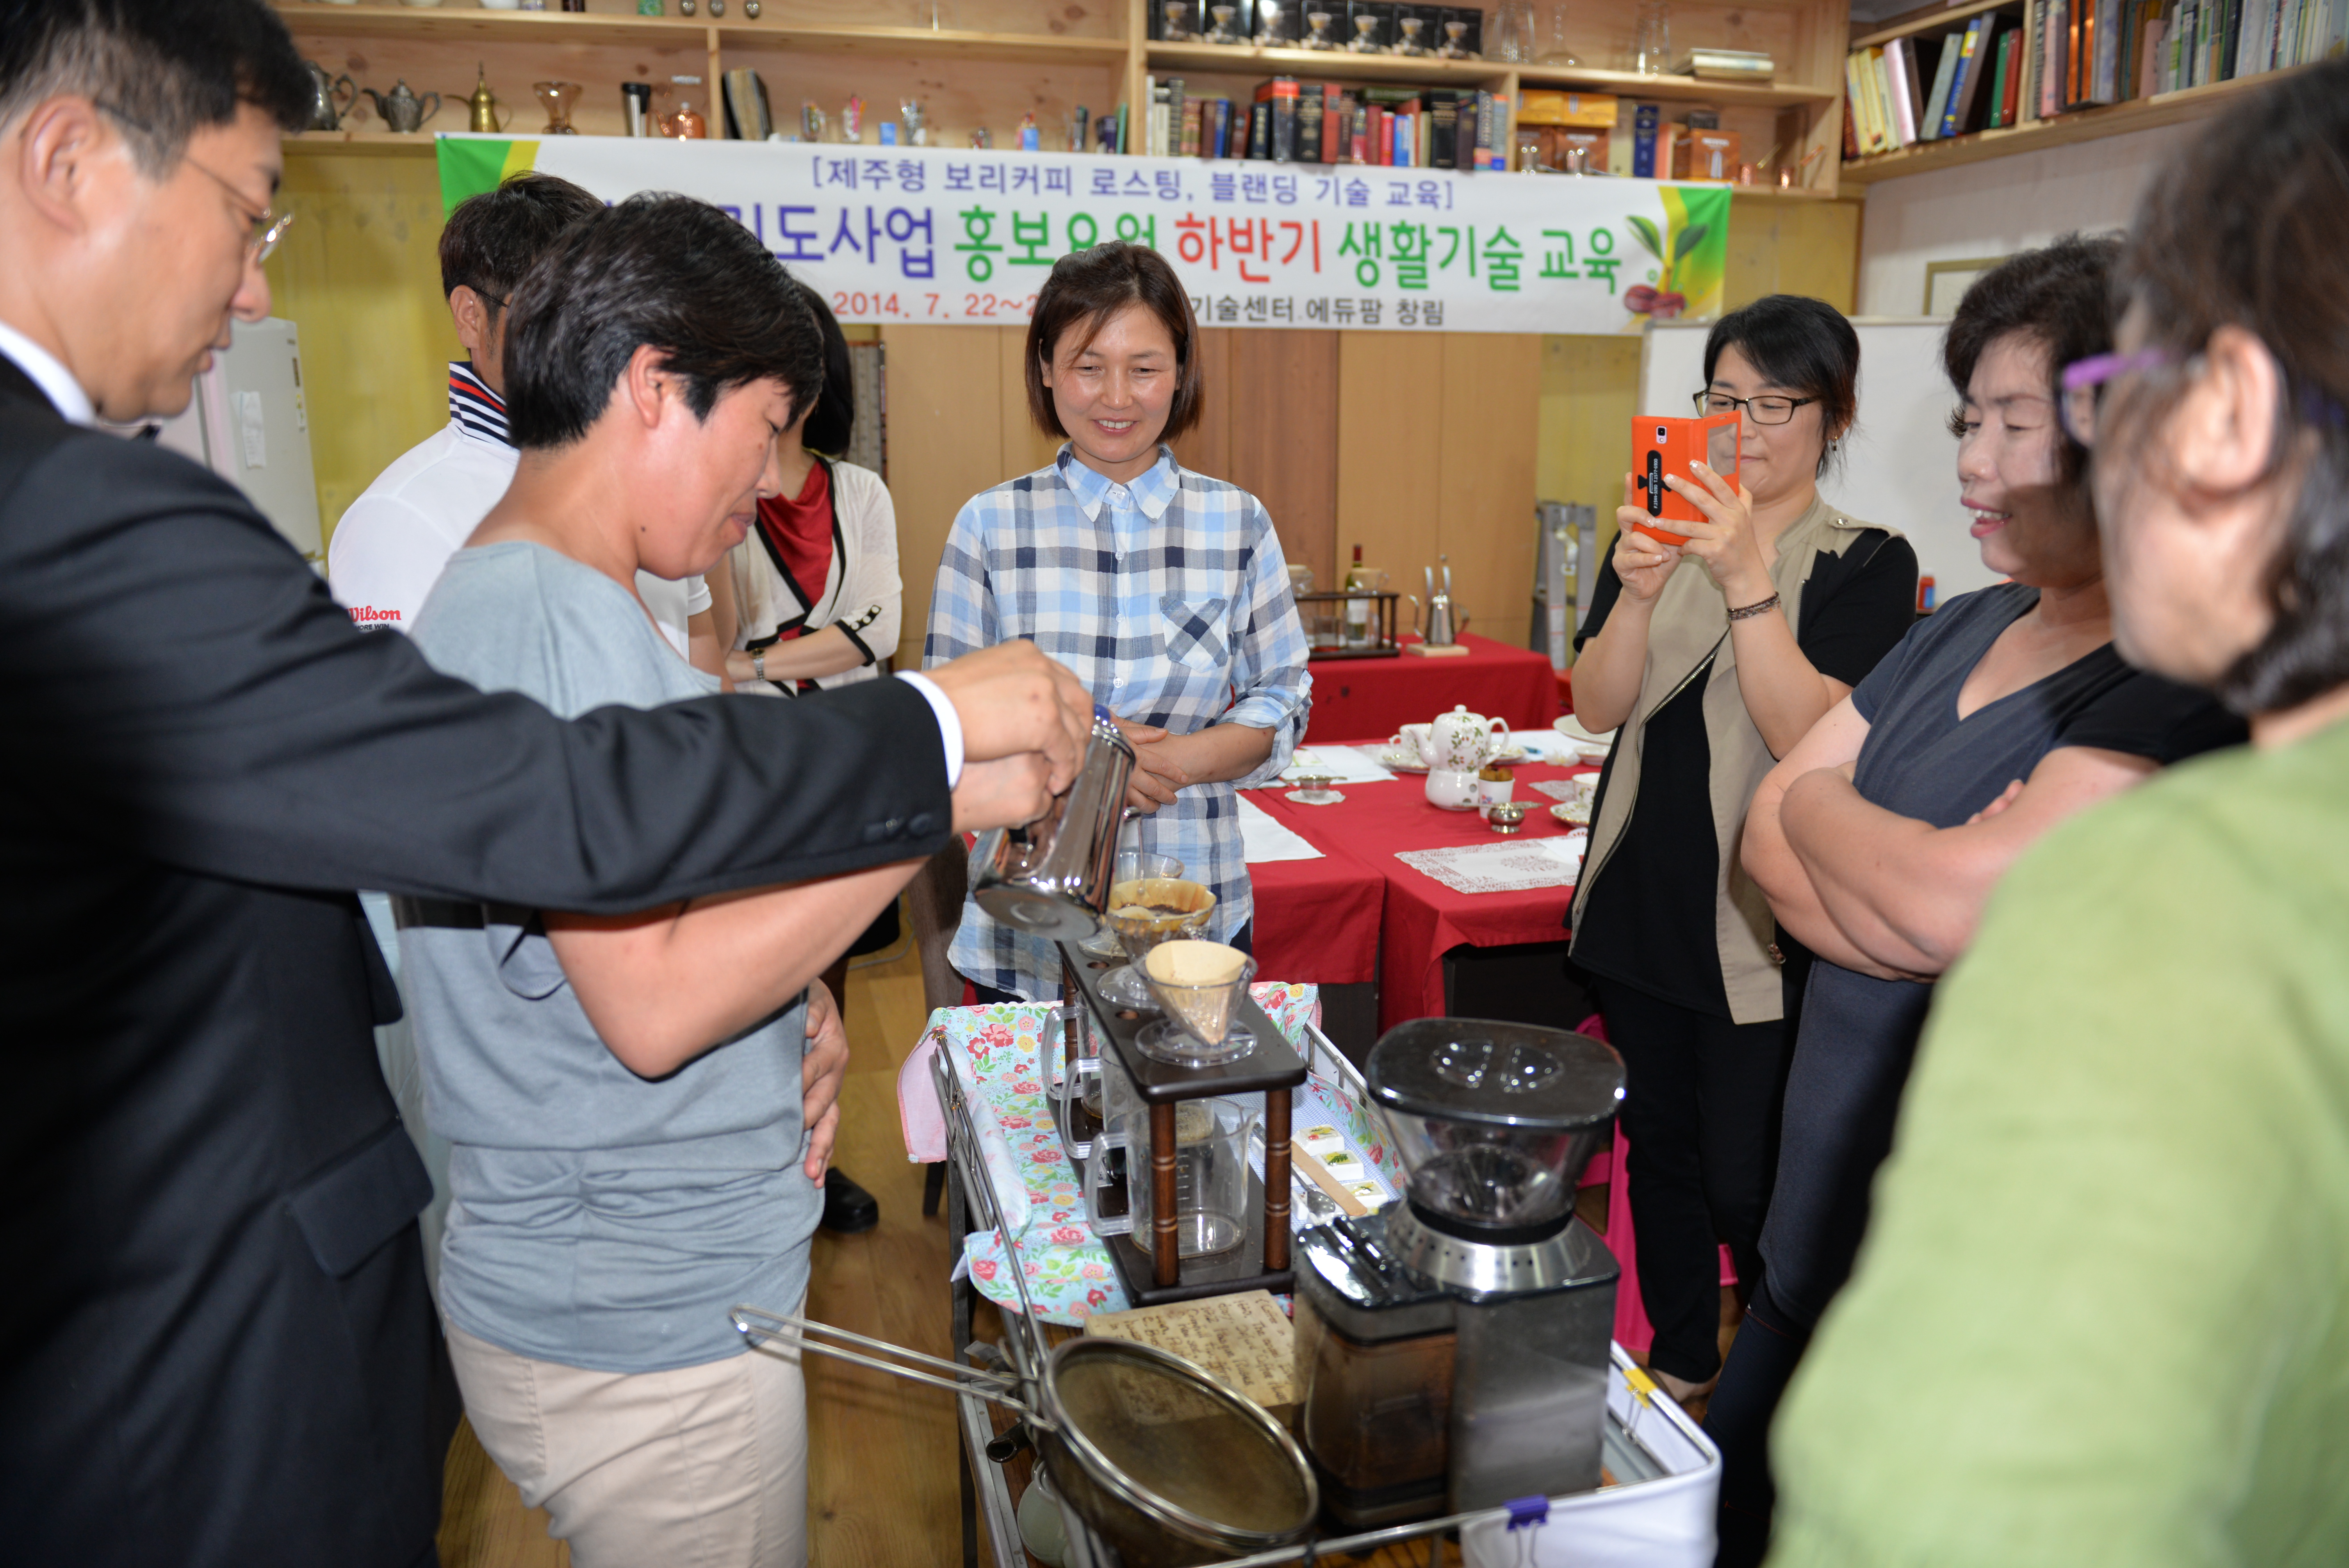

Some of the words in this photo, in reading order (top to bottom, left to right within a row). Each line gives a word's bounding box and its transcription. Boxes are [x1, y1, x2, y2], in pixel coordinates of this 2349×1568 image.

[813, 156, 926, 192] [제주형
[943, 162, 1072, 196] 보리커피
[1090, 168, 1193, 201] 로스팅,
[1210, 171, 1299, 205] 블랜딩
[1314, 176, 1371, 207] 기술
[1385, 180, 1453, 210] 교육]
[1175, 212, 1321, 284] 하반기
[1338, 221, 1523, 291] 생활기술
[1540, 228, 1621, 294] 교육
[833, 291, 911, 319] 2014.
[926, 294, 948, 318] 7.
[1397, 300, 1443, 326] 창림
[1253, 1321, 1267, 1336] The
